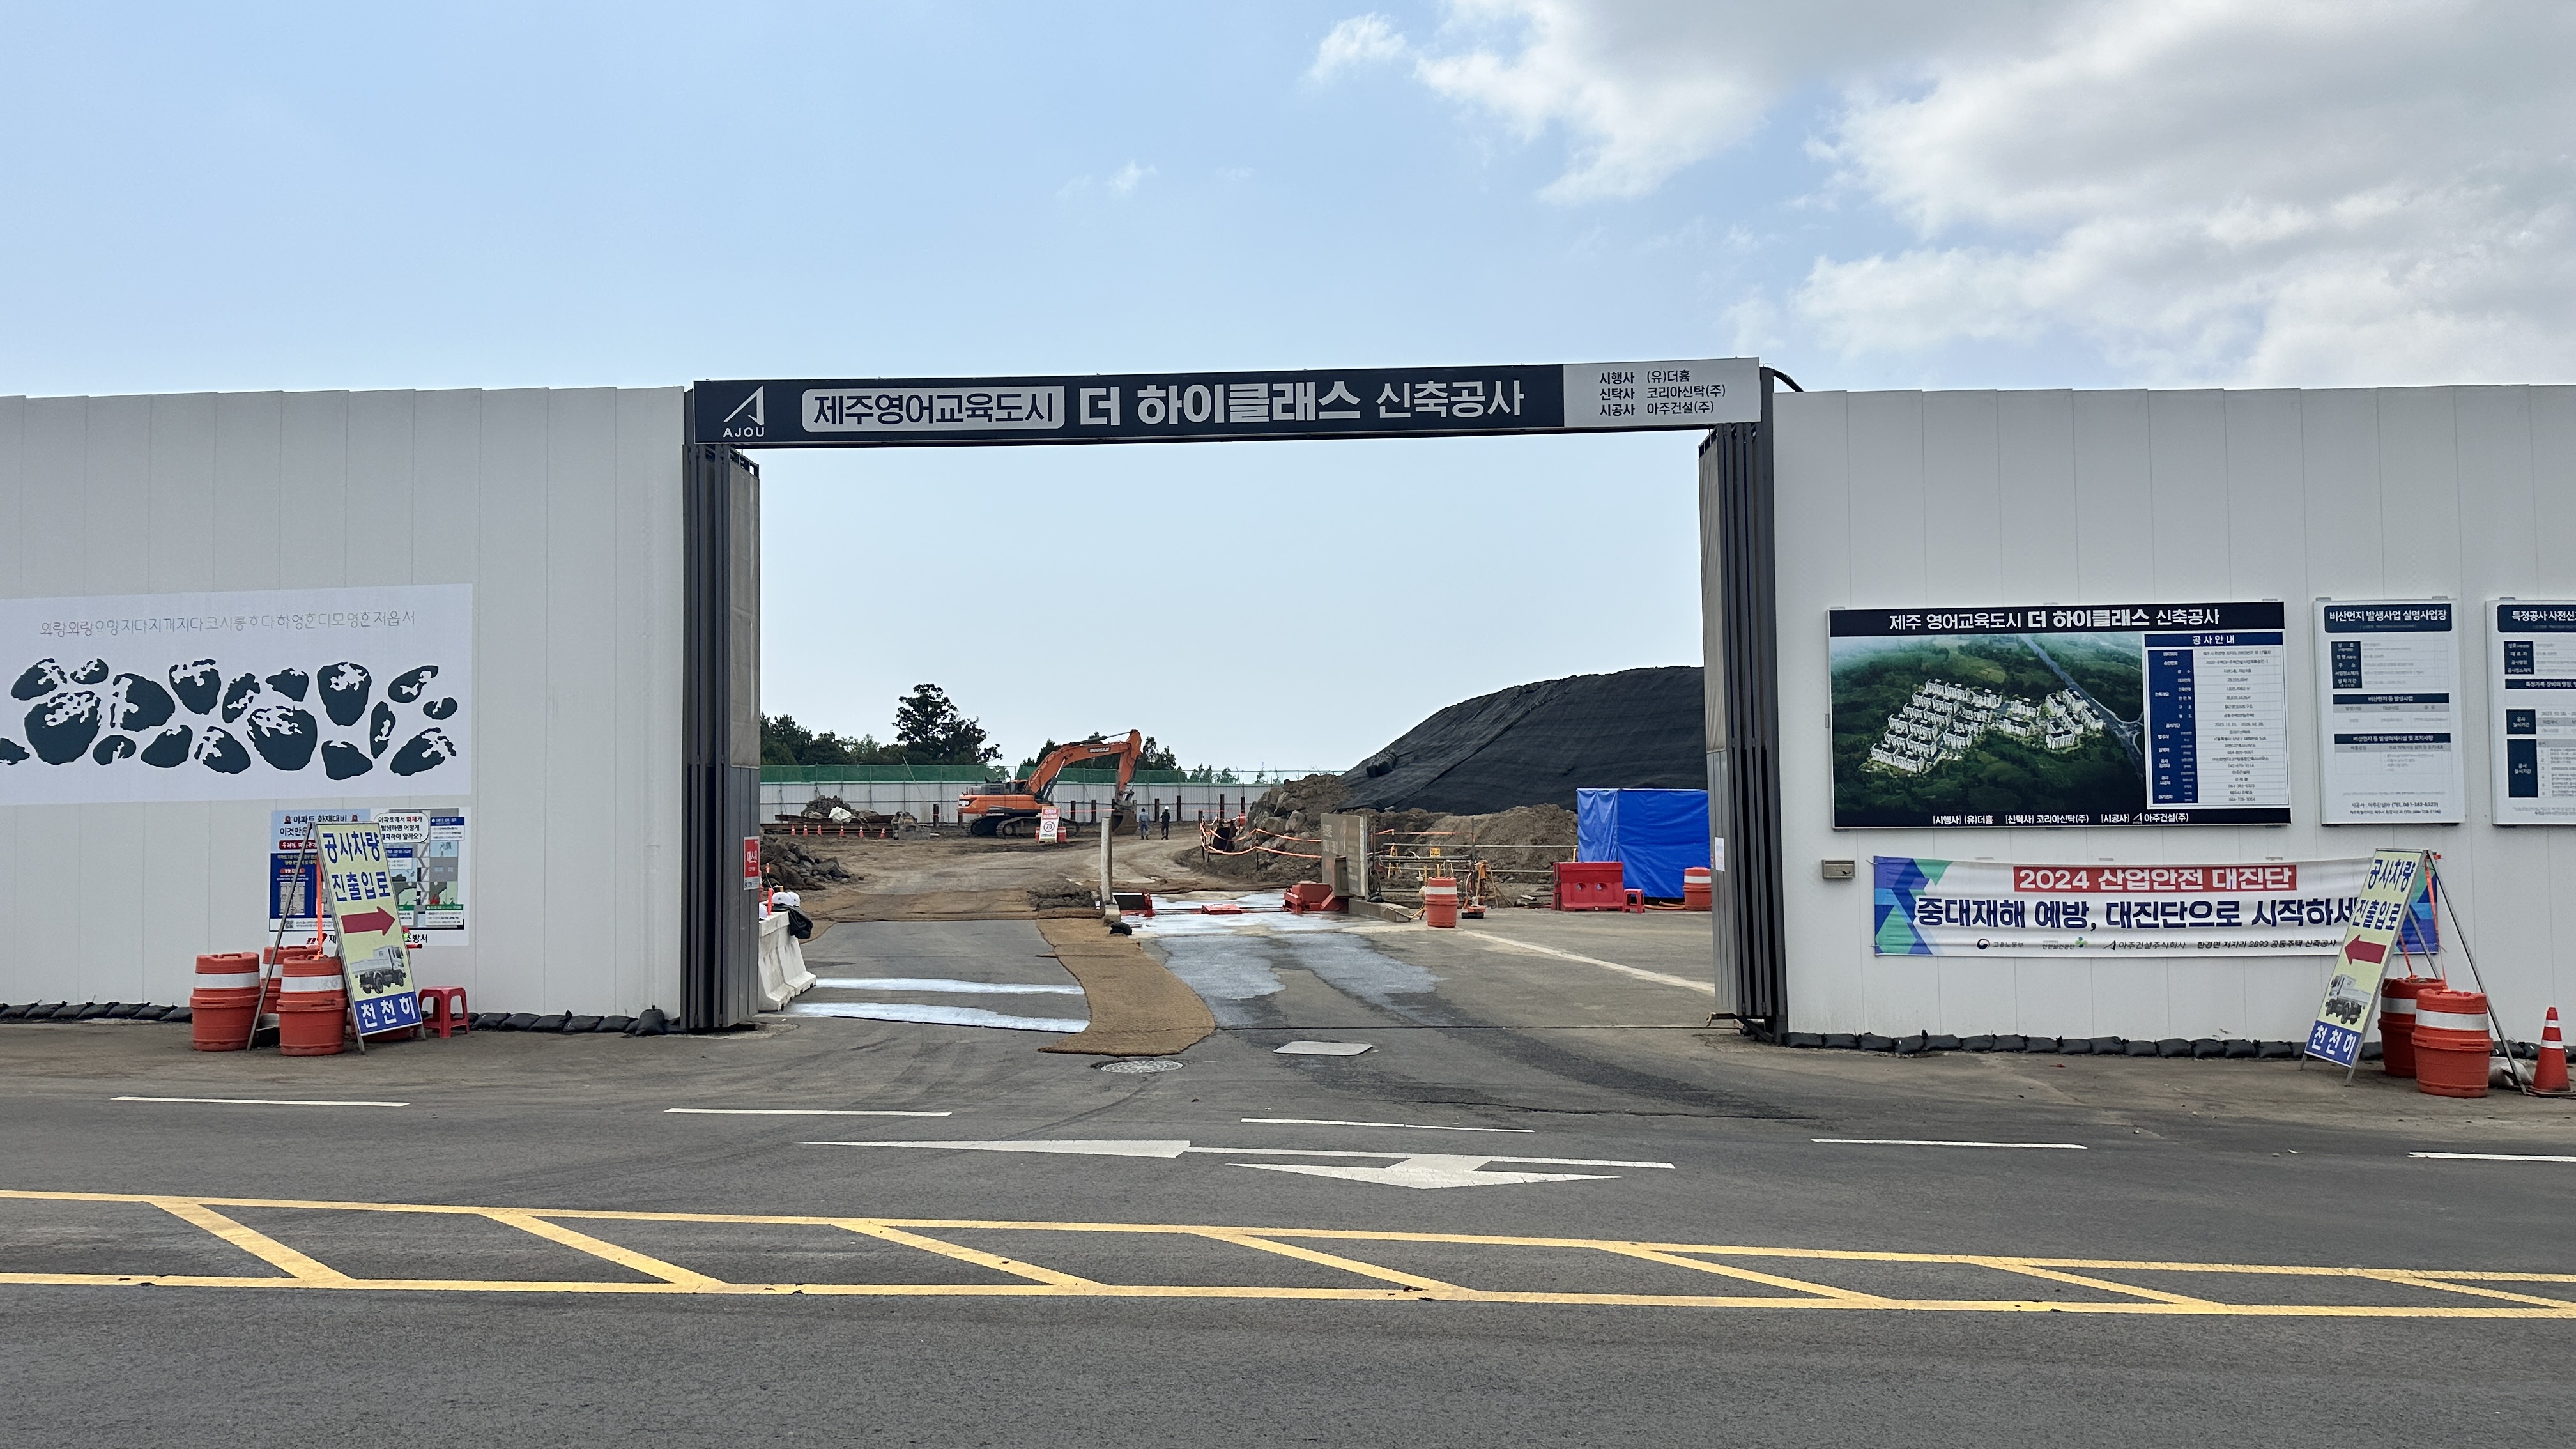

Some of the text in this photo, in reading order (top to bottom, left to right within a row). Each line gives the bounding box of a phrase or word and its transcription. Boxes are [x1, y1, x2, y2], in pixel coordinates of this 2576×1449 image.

[1599, 372, 1635, 385] 시행사
[813, 379, 1525, 426] 제주영어교육도시 더 하이클래스 신축공사
[1599, 384, 1726, 401] 신탁사 코리아신탁(주)
[1599, 401, 1714, 416] 시공사 아주건설(주)
[723, 427, 765, 438] AJOU
[1889, 609, 2220, 631] 제주 영어교육도시 더 하이클래스 신축공사
[2329, 610, 2448, 622] 비산먼지 발생사업 실명사업장
[2511, 611, 2547, 622] 특정공사
[293, 815, 315, 824] 아파트
[1933, 815, 1962, 825] [시행사]
[2005, 814, 2034, 824] [신탁사]
[2036, 813, 2089, 824] 코리아신탁(주)
[2101, 813, 2130, 824] [시공사]
[2144, 813, 2189, 823] 아주건설(주)
[323, 831, 380, 864] 공사차량
[331, 871, 391, 901] 진출입로
[2019, 867, 2292, 891] 2024 산업안전 대진단
[2368, 859, 2416, 893] 공사차량
[1917, 896, 2358, 931] 중대재해 예방, 대진단으로 시작하세
[2352, 899, 2402, 931] 진출입로
[2118, 940, 2186, 950] 아주건설주식회사
[2196, 940, 2221, 949] 한경면
[2223, 940, 2247, 949] 저지리
[2271, 940, 2303, 949] 공동주택
[2305, 939, 2338, 949] 신축공사
[360, 995, 417, 1029] 천천히
[2312, 1024, 2357, 1061] 천천히
